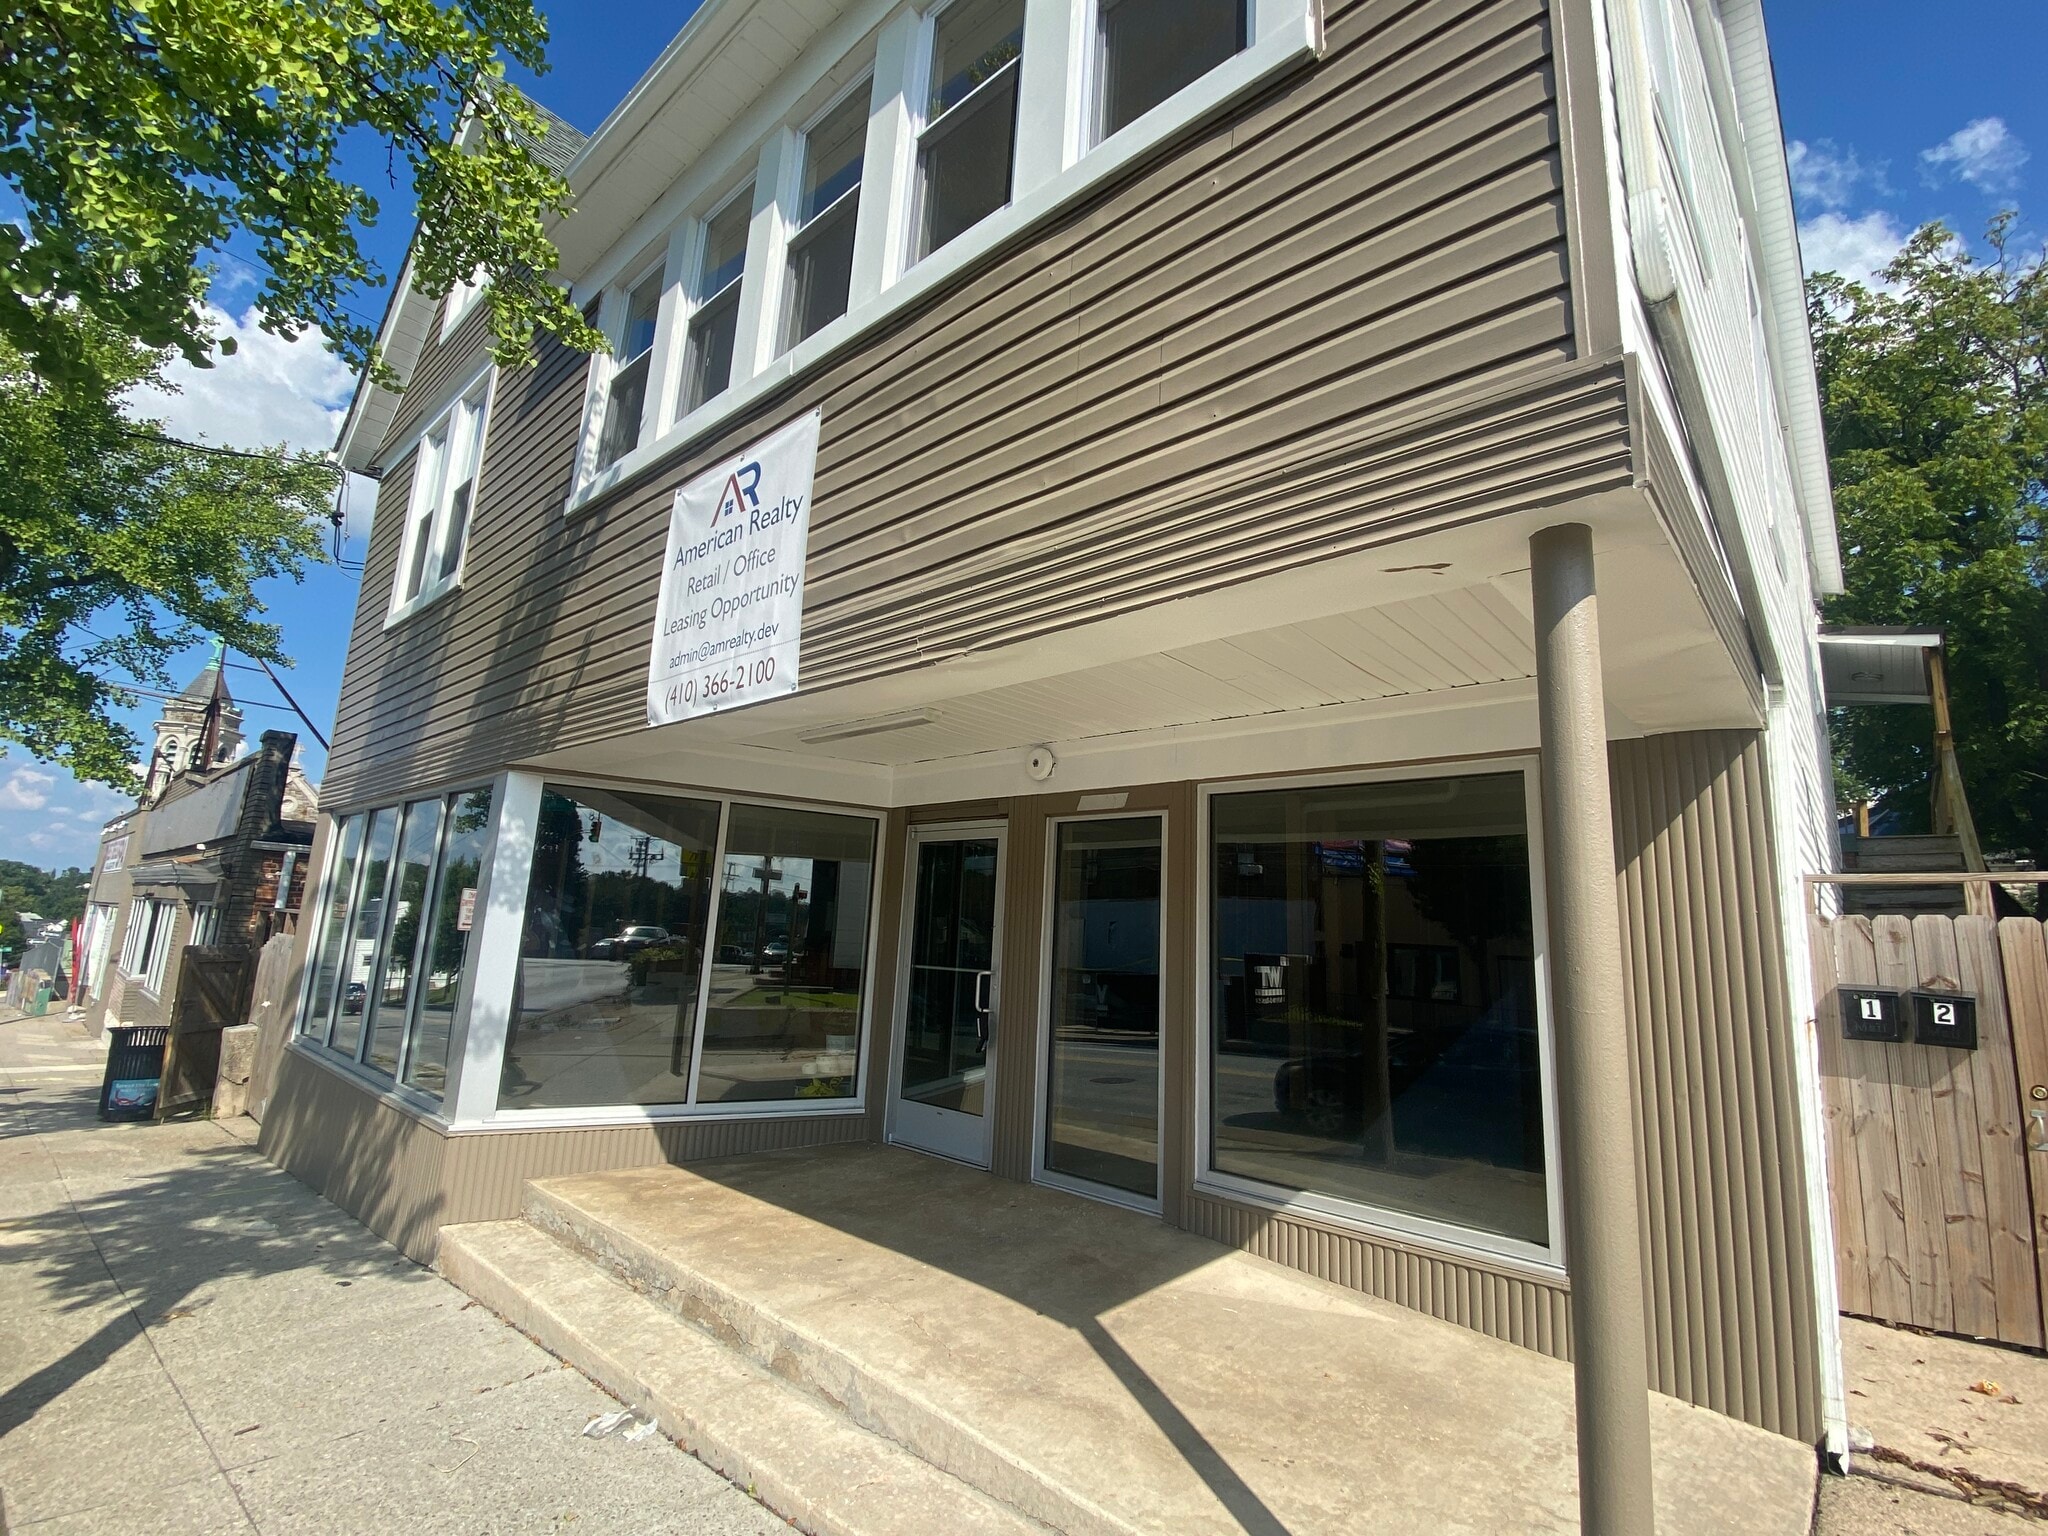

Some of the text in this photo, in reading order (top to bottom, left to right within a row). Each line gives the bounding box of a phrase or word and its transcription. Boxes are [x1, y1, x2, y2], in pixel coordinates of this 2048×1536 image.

[710, 460, 762, 528] AR
[673, 495, 804, 571] American Realty
[687, 547, 776, 597] Retail / Office
[663, 573, 800, 637] Leasing Opportunity
[669, 621, 780, 670] admin@amrealty.dev
[665, 656, 776, 714] (410) 366-2100
[1866, 1000, 1877, 1018] 1
[1936, 1004, 1952, 1023] 2
